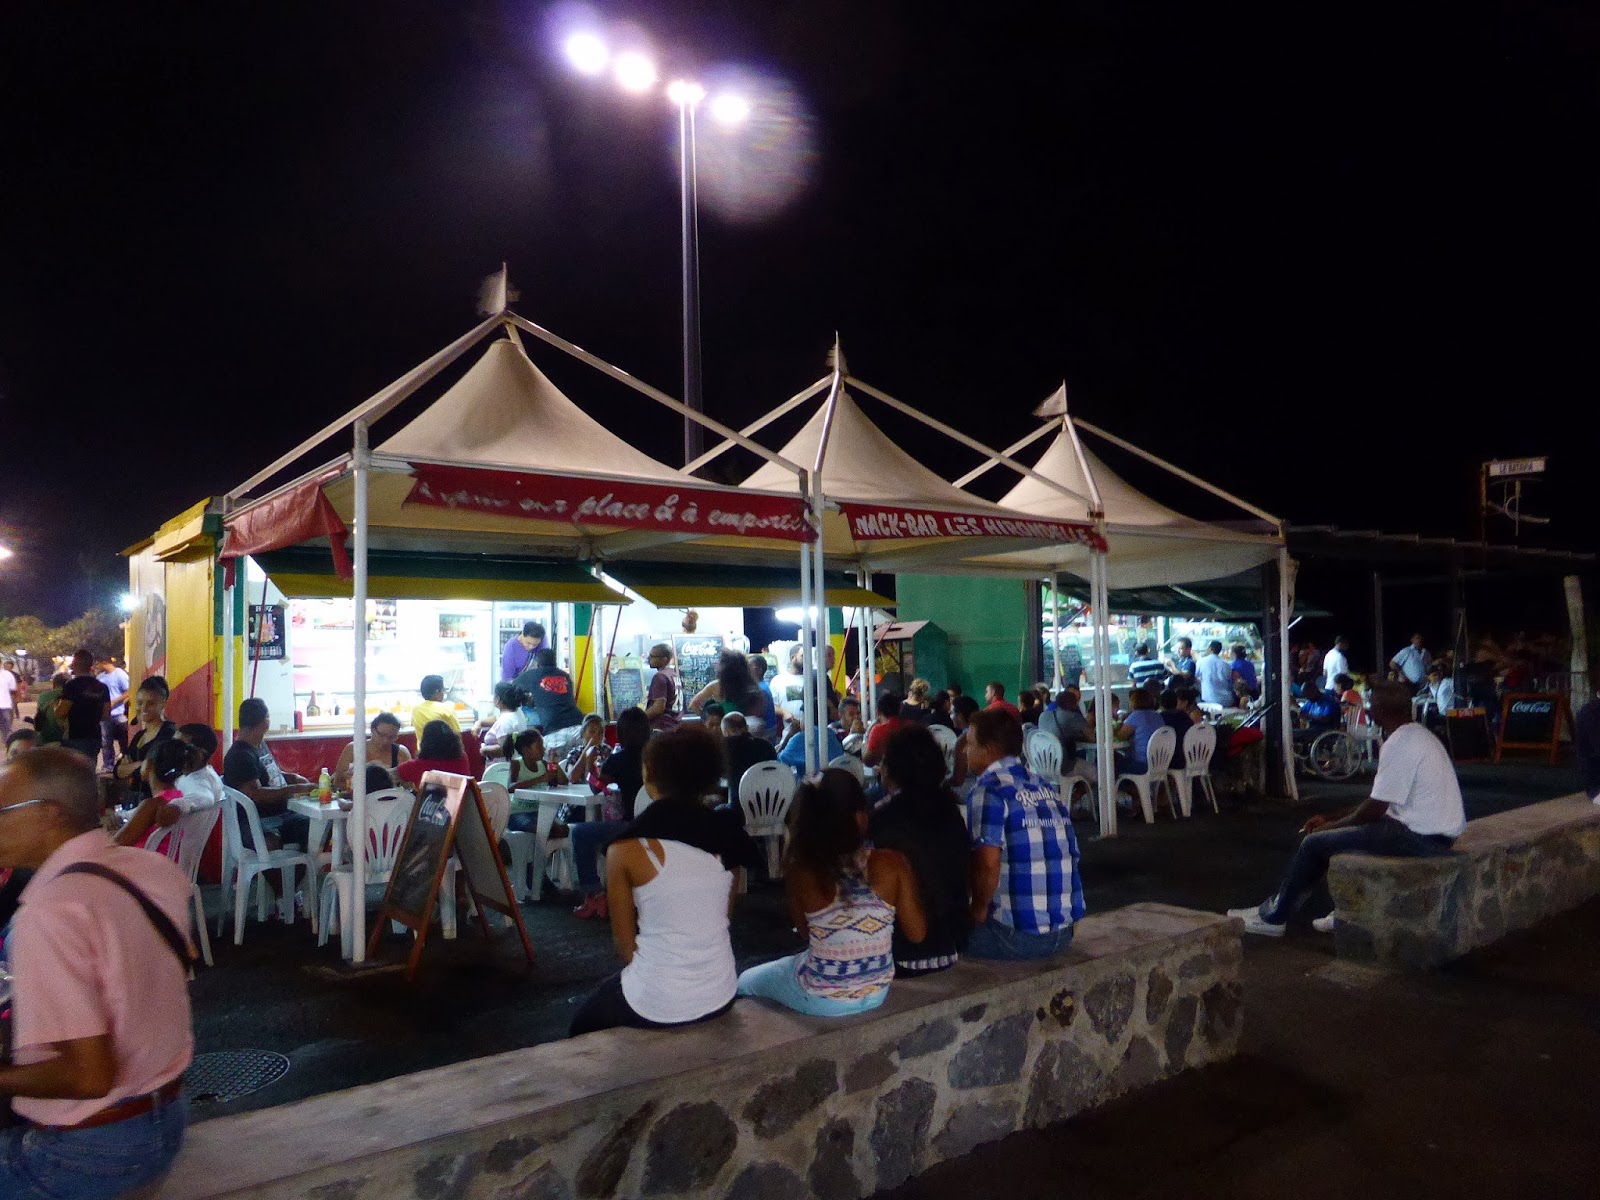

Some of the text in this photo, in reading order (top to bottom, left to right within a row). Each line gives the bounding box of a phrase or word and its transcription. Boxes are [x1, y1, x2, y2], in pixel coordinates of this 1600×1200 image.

[572, 492, 651, 524] place
[681, 501, 699, 524] à
[855, 511, 943, 537] NACK-BAR
[945, 514, 981, 537] LES
